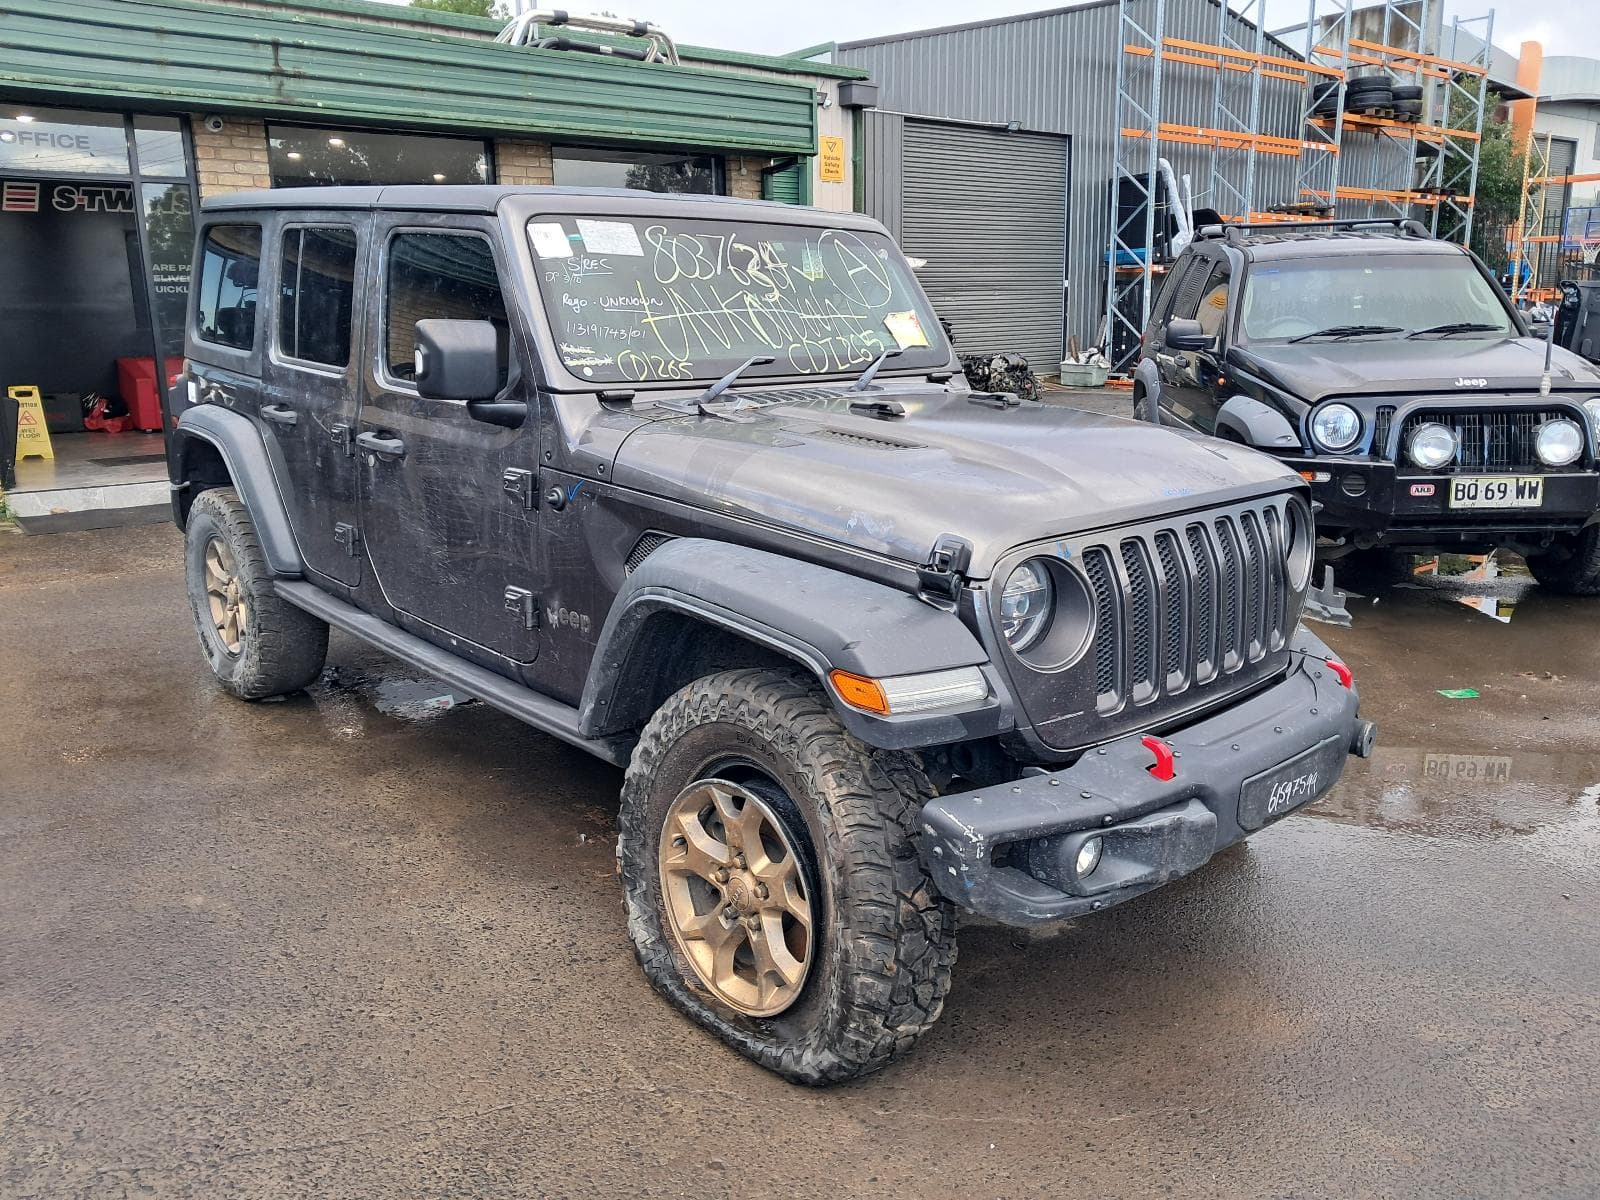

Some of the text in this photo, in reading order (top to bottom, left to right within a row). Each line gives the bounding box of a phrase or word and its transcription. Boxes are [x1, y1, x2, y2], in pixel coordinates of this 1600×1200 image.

[0, 130, 90, 150] OFFICE
[152, 264, 176, 272] ARE
[1454, 377, 1488, 388] Jeep
[1484, 482, 1508, 500] 69
[1515, 480, 1540, 500] WW
